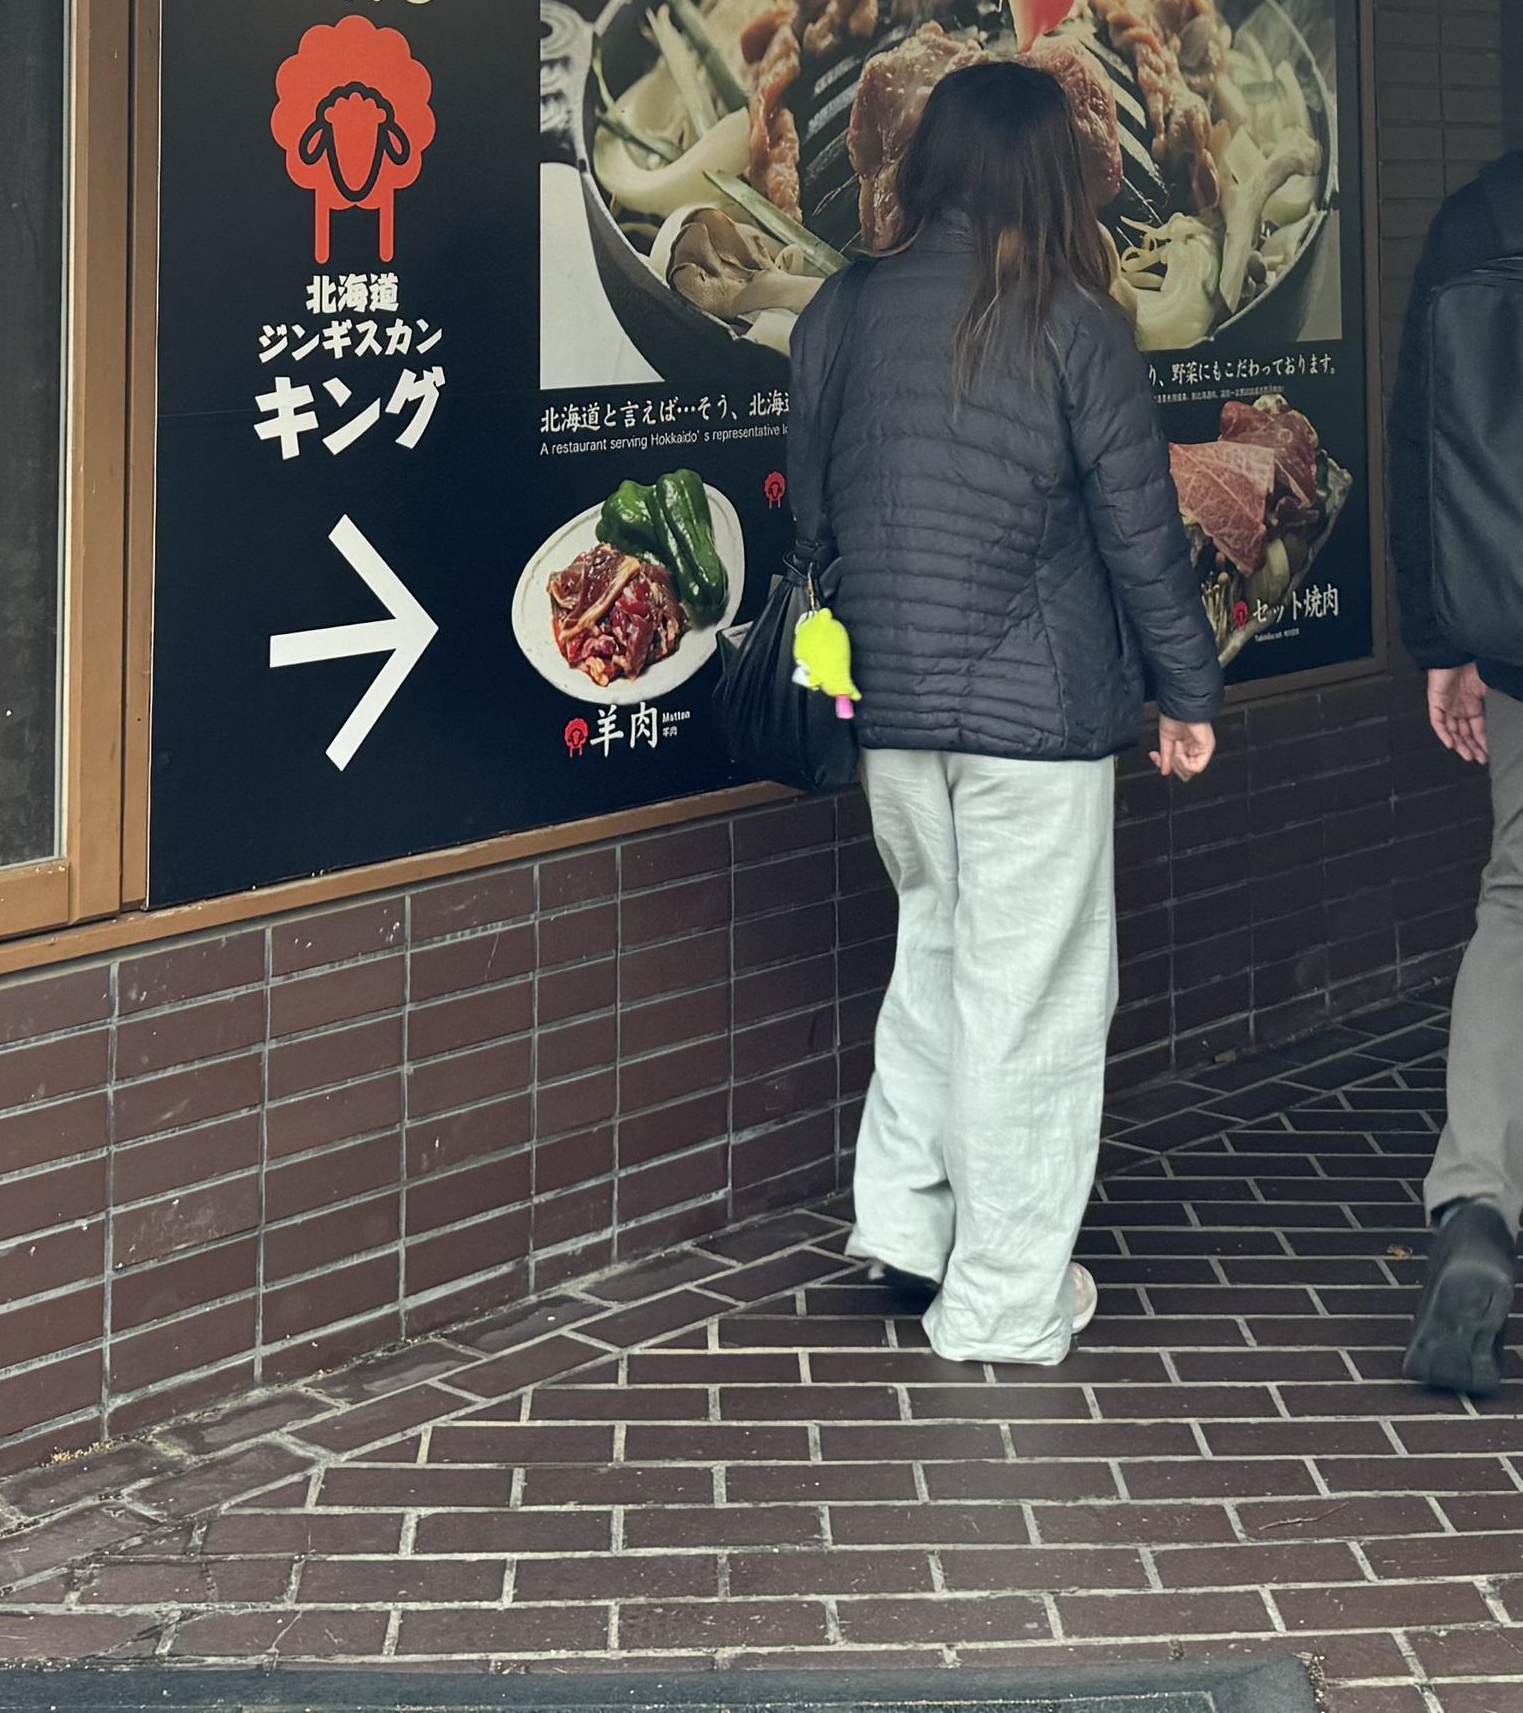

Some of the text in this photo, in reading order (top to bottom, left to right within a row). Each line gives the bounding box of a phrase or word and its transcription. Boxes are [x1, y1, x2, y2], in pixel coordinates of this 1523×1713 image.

[305, 273, 399, 314] 北海道
[258, 319, 444, 363] ジンギスカン
[254, 367, 445, 459] キング
[540, 442, 549, 456] A
[551, 438, 607, 454] restaurant
[610, 435, 648, 450] serving
[712, 424, 780, 443] representative
[1253, 583, 1338, 623] セット焼肉
[589, 701, 658, 757] 羊肉
